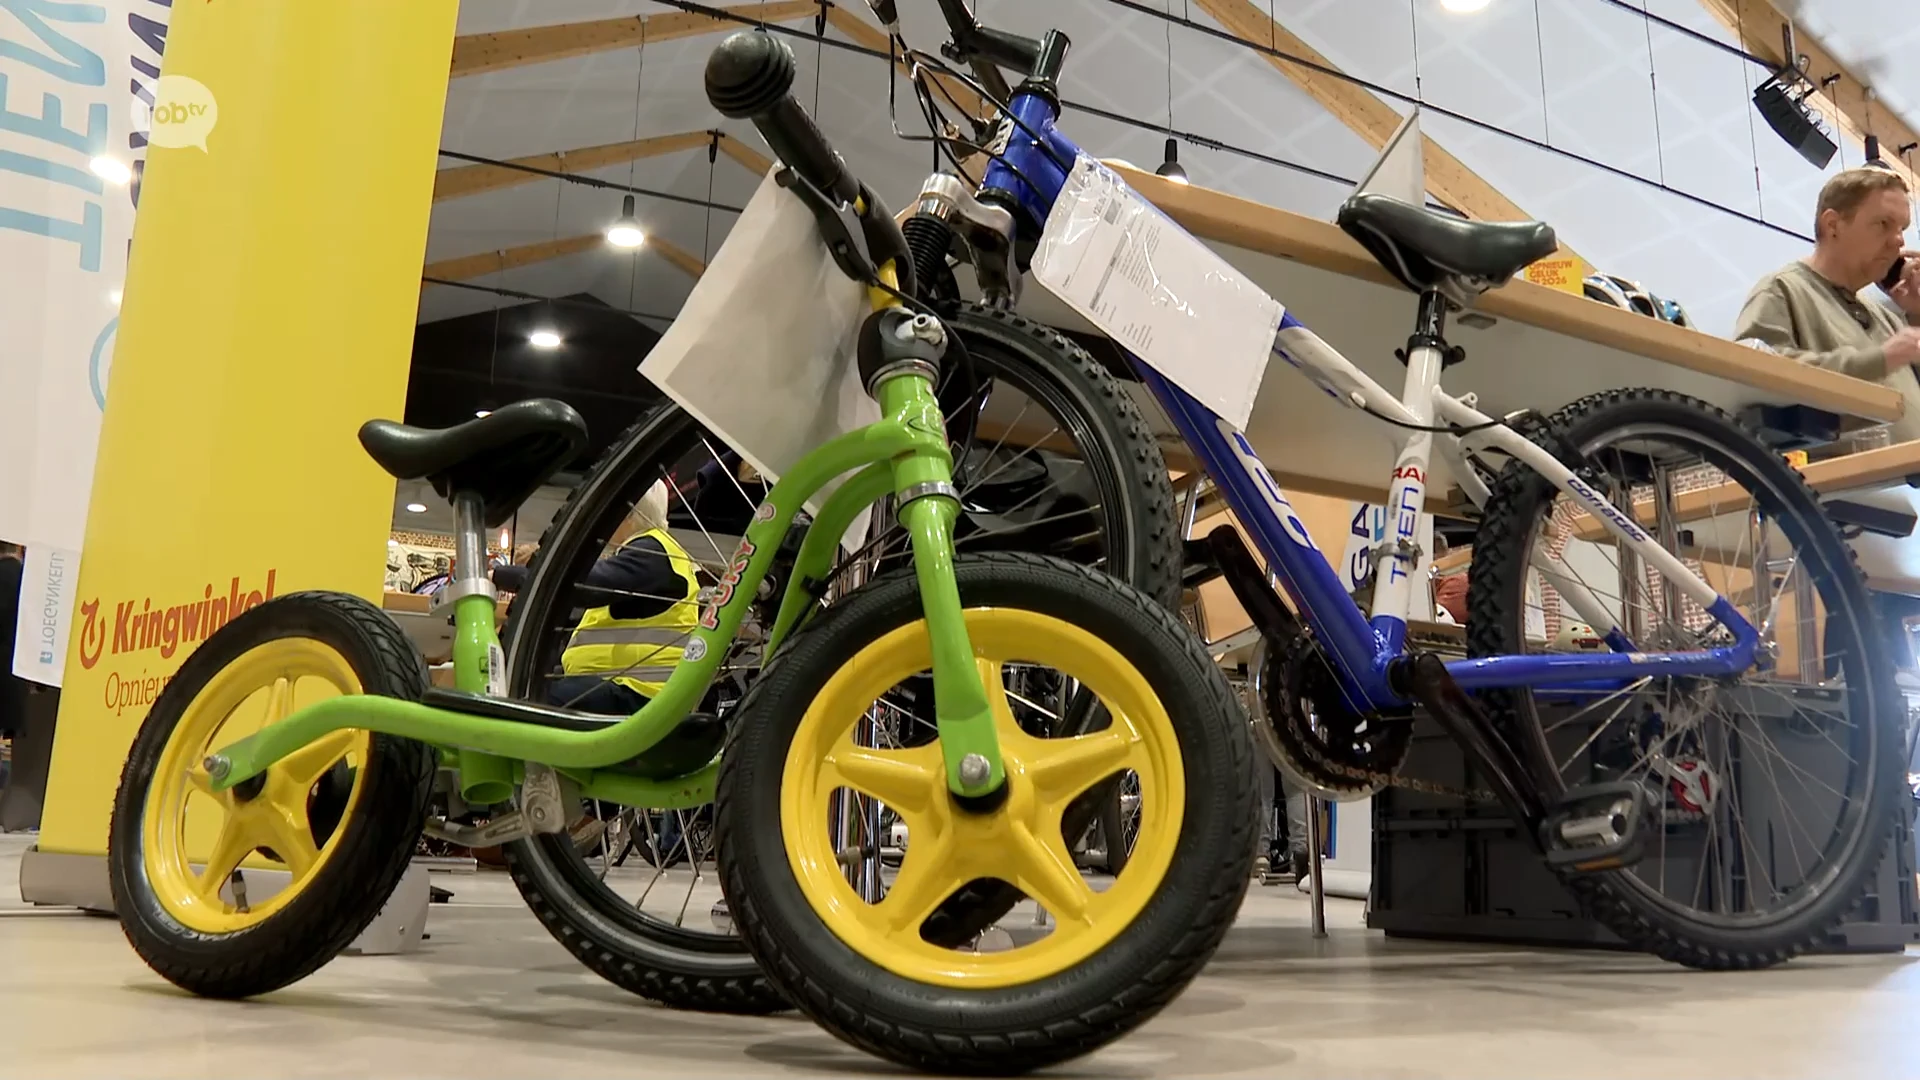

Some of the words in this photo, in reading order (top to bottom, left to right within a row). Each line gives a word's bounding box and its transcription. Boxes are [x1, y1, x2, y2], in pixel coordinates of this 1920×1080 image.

[1541, 276, 1568, 285] 2026
[1567, 479, 1646, 542] corratec
[700, 535, 756, 631] PUKY
[105, 668, 176, 717] Opnieu
